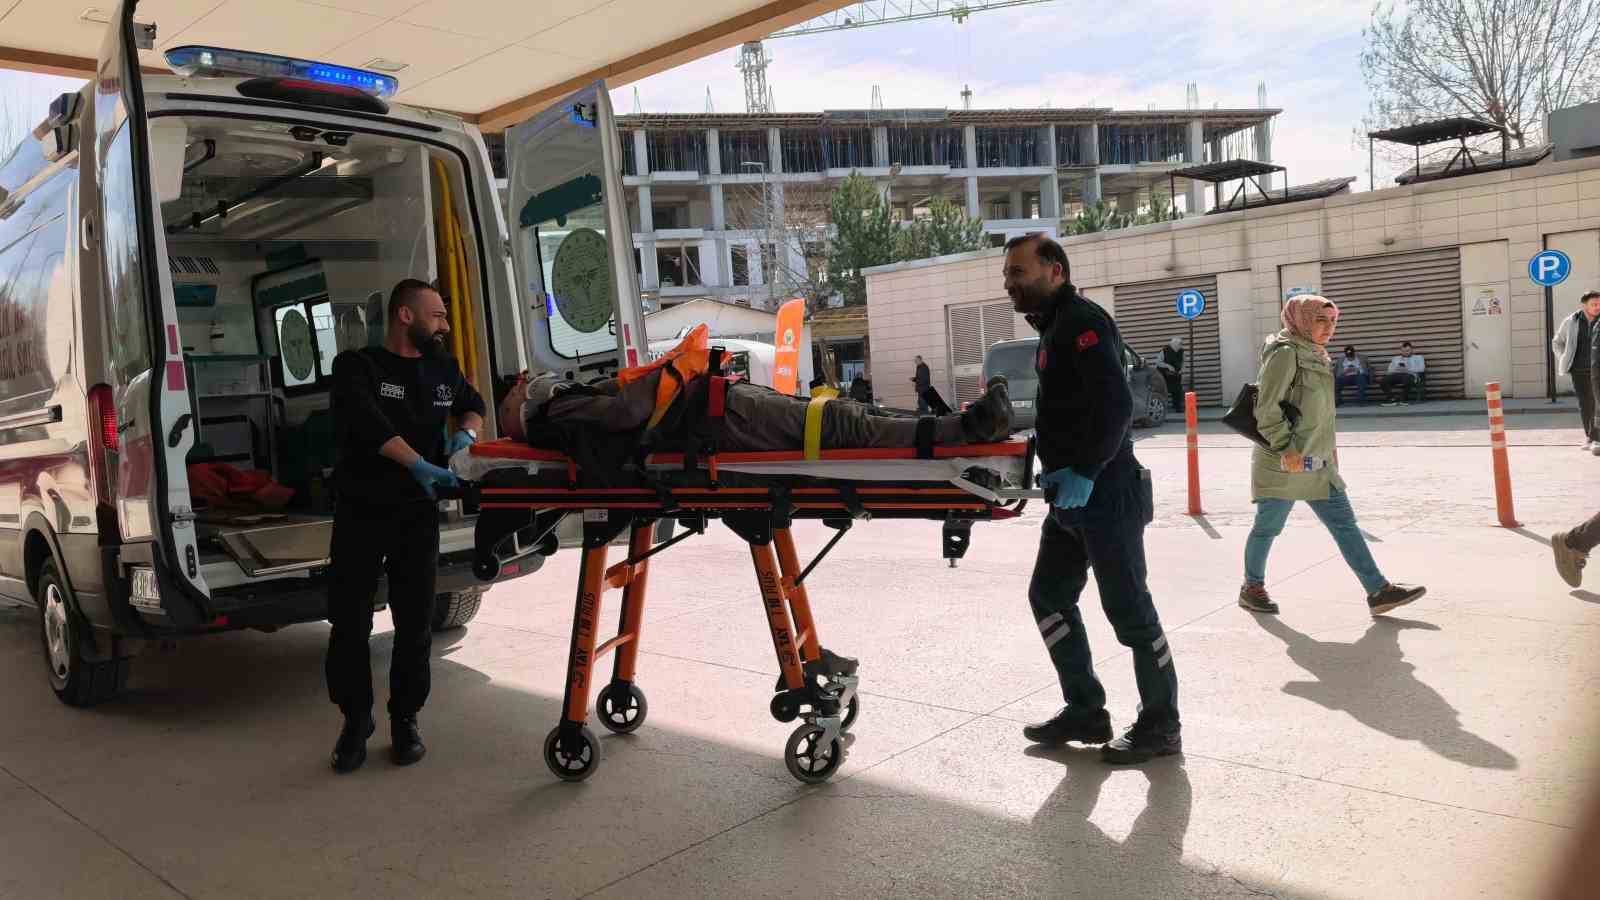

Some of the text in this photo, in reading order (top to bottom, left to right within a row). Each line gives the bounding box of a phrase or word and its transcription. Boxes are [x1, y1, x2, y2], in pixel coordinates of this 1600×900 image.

[1538, 256, 1560, 280] P
[1183, 294, 1198, 314] P
[575, 647, 588, 667] TAY
